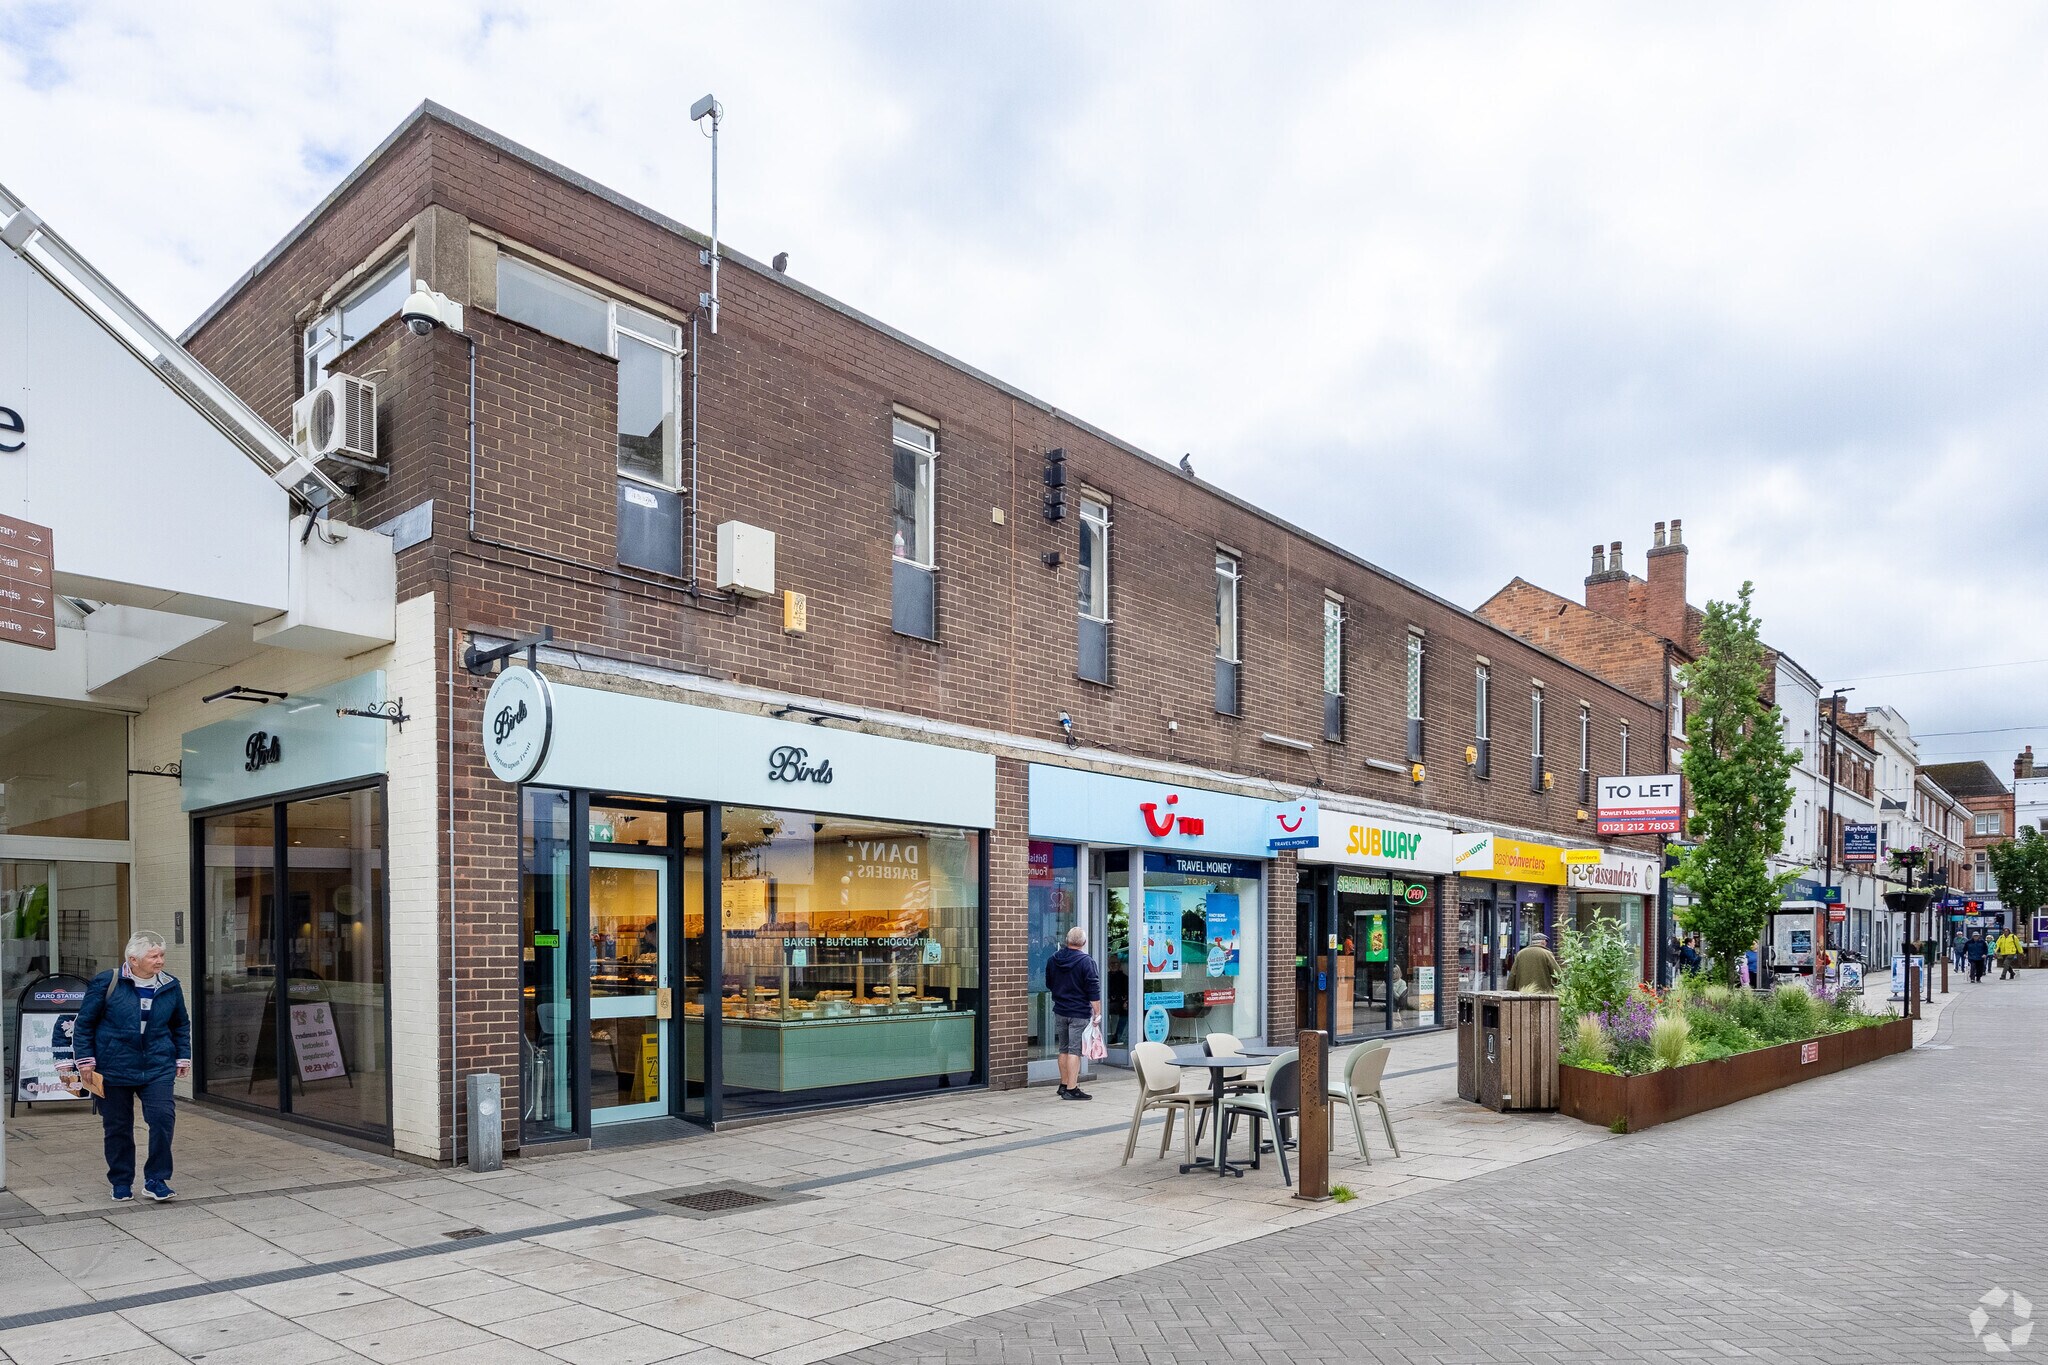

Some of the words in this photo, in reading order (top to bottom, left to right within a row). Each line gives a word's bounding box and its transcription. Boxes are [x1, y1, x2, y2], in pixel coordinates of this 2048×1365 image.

[494, 700, 527, 745] Birds
[245, 731, 282, 772] Birds
[768, 745, 833, 784] Birds
[1605, 785, 1631, 799] TO
[1639, 784, 1673, 798] LET
[1602, 823, 1624, 832] 0121
[1627, 823, 1645, 831] 212
[1648, 822, 1675, 830] 7803
[1346, 825, 1422, 861] SUBWAY
[1455, 839, 1488, 864] SUBWAY
[1177, 860, 1206, 872] TRAVEL
[1206, 862, 1232, 874] MONEY
[1337, 876, 1371, 892] SEATING
[1370, 877, 1404, 896] UPSTIRS
[1407, 889, 1424, 900] OPEN
[783, 938, 816, 947] BAKER
[826, 938, 868, 947] BUTCHER
[877, 938, 937, 948] CHOCOLATIER
